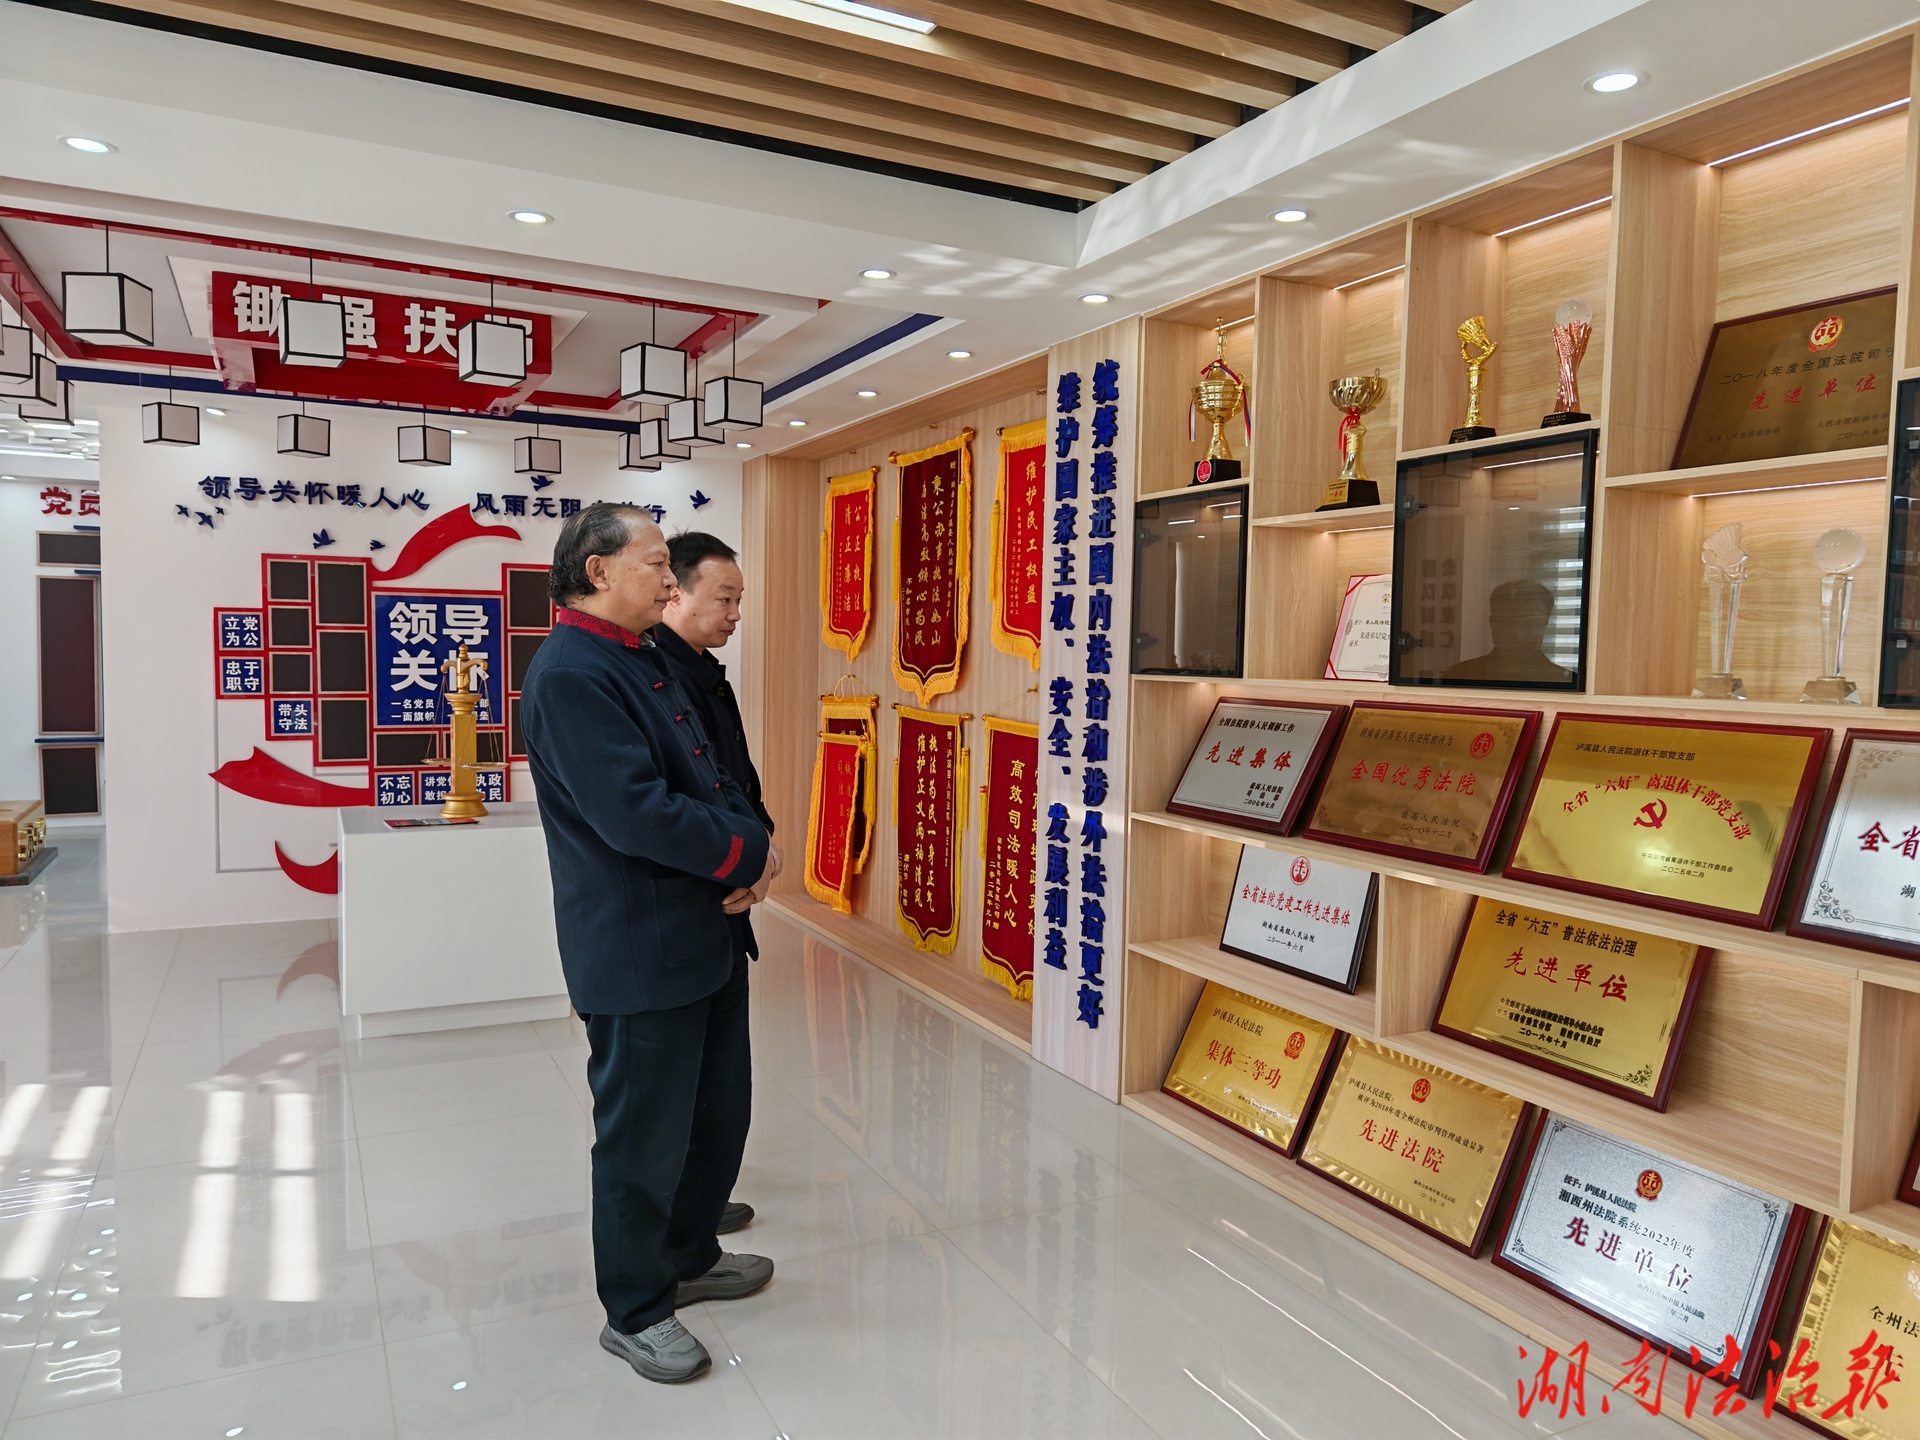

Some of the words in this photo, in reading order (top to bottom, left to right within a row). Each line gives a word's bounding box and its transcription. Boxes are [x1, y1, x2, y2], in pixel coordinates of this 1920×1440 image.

[233, 281, 533, 365] 锄强扶
[1750, 373, 1876, 411] 先进单位
[40, 486, 100, 516] 党员
[199, 475, 430, 511] 领导关怀暖人心
[472, 492, 667, 524] 风雨无阻行
[1025, 460, 1038, 604] 维护民工权益
[844, 503, 852, 612] 清正廉洁
[854, 505, 862, 612] 公正执法
[931, 474, 945, 647] 秉公办事执法如山
[225, 616, 259, 631] 立党
[388, 601, 490, 645] 领导
[1360, 631, 1391, 641] 先进基层党
[225, 632, 259, 647] 为公
[226, 661, 260, 676] 忠于
[226, 677, 260, 691] 职守
[390, 649, 490, 692] 关怀
[278, 703, 308, 717] 带头
[391, 698, 435, 709] 一名党员
[1076, 359, 1120, 1030] 统筹推进国内法治和涉外法治更好
[278, 717, 308, 731] 守法
[391, 711, 435, 722] 一面旗帜
[1218, 717, 1295, 733] 全国法院指导人民调解工作
[1360, 727, 1454, 746] 湖南省泸溪县人民法院被评为
[1575, 743, 1696, 762] 泸溪县人民法院退休干部党支部
[1205, 740, 1292, 772] 先进集体
[380, 776, 411, 790] 不忘
[1249, 782, 1284, 794] 最高人民法院
[1351, 760, 1476, 796] 全国优秀法院
[380, 791, 411, 805] 初心
[1246, 790, 1280, 801] 司法部
[914, 732, 926, 908] 维护正义两袖清风
[926, 733, 938, 913] 执法为民一身正气
[1401, 810, 1460, 828] 最高人民法院
[1003, 759, 1025, 928] 高效司法暖人心
[1857, 821, 1920, 860] 全省
[1242, 883, 1351, 927] 全省法院党建工作先进集体
[1900, 884, 1917, 899] 湖
[1261, 920, 1316, 943] 湖南省高级人民法院
[1495, 908, 1638, 957] 全省“六五”普法依法治理
[1503, 947, 1629, 1002] 先进单位
[1212, 1007, 1264, 1037] 泸溪县人民法院
[1207, 1039, 1282, 1090] 集体三等功
[1358, 1119, 1445, 1173] 先进法院
[1558, 1188, 1696, 1259] 湘西州法院系统2022年度
[1563, 1216, 1693, 1295] 先进单位
[1868, 1305, 1920, 1338] 全州法
